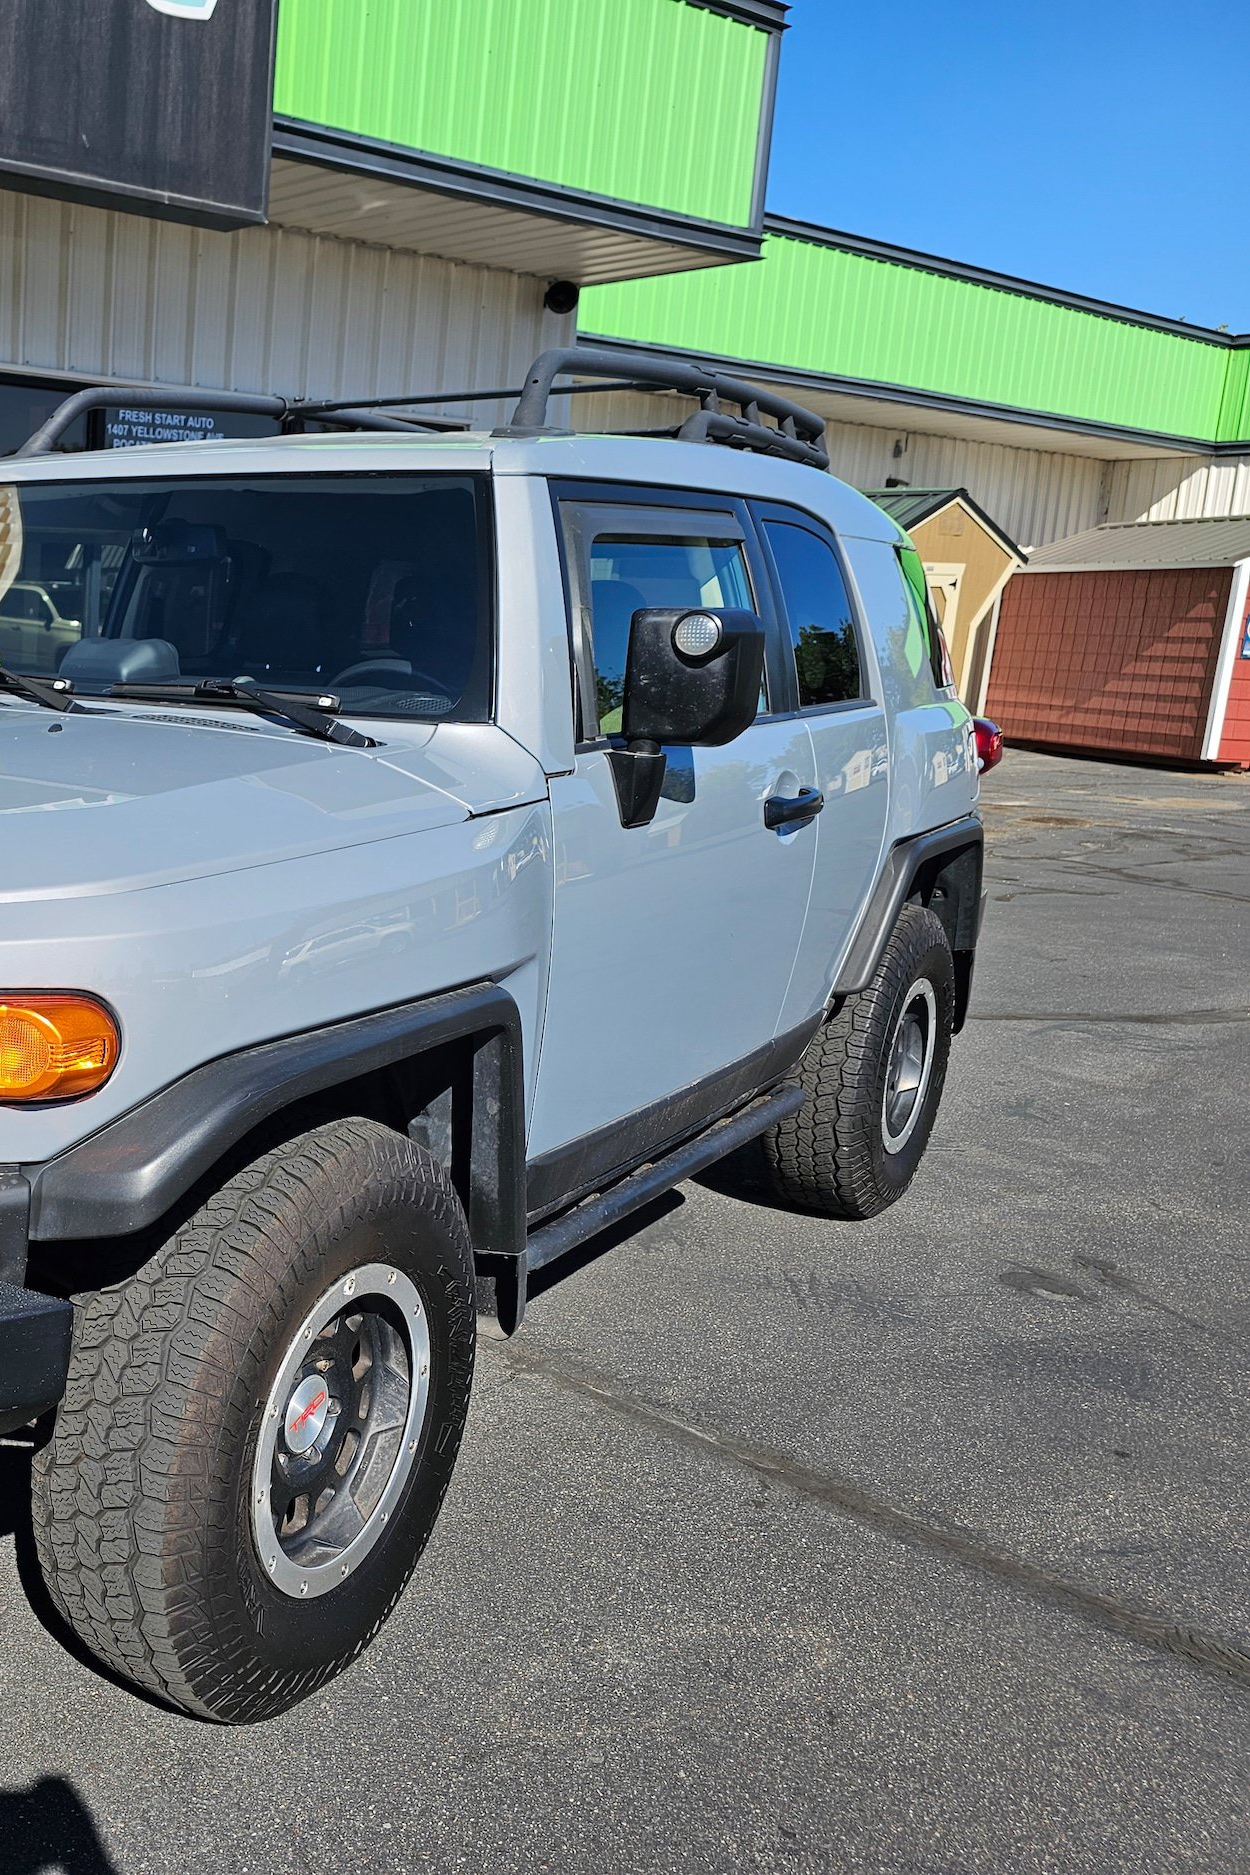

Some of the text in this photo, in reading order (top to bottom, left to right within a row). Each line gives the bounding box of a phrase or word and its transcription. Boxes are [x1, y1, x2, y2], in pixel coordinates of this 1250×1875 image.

[119, 410, 214, 429] FRESH START AUTO
[107, 424, 129, 435] 1407
[131, 425, 204, 441] YELLOWSTONE
[289, 1392, 325, 1432] TRD
